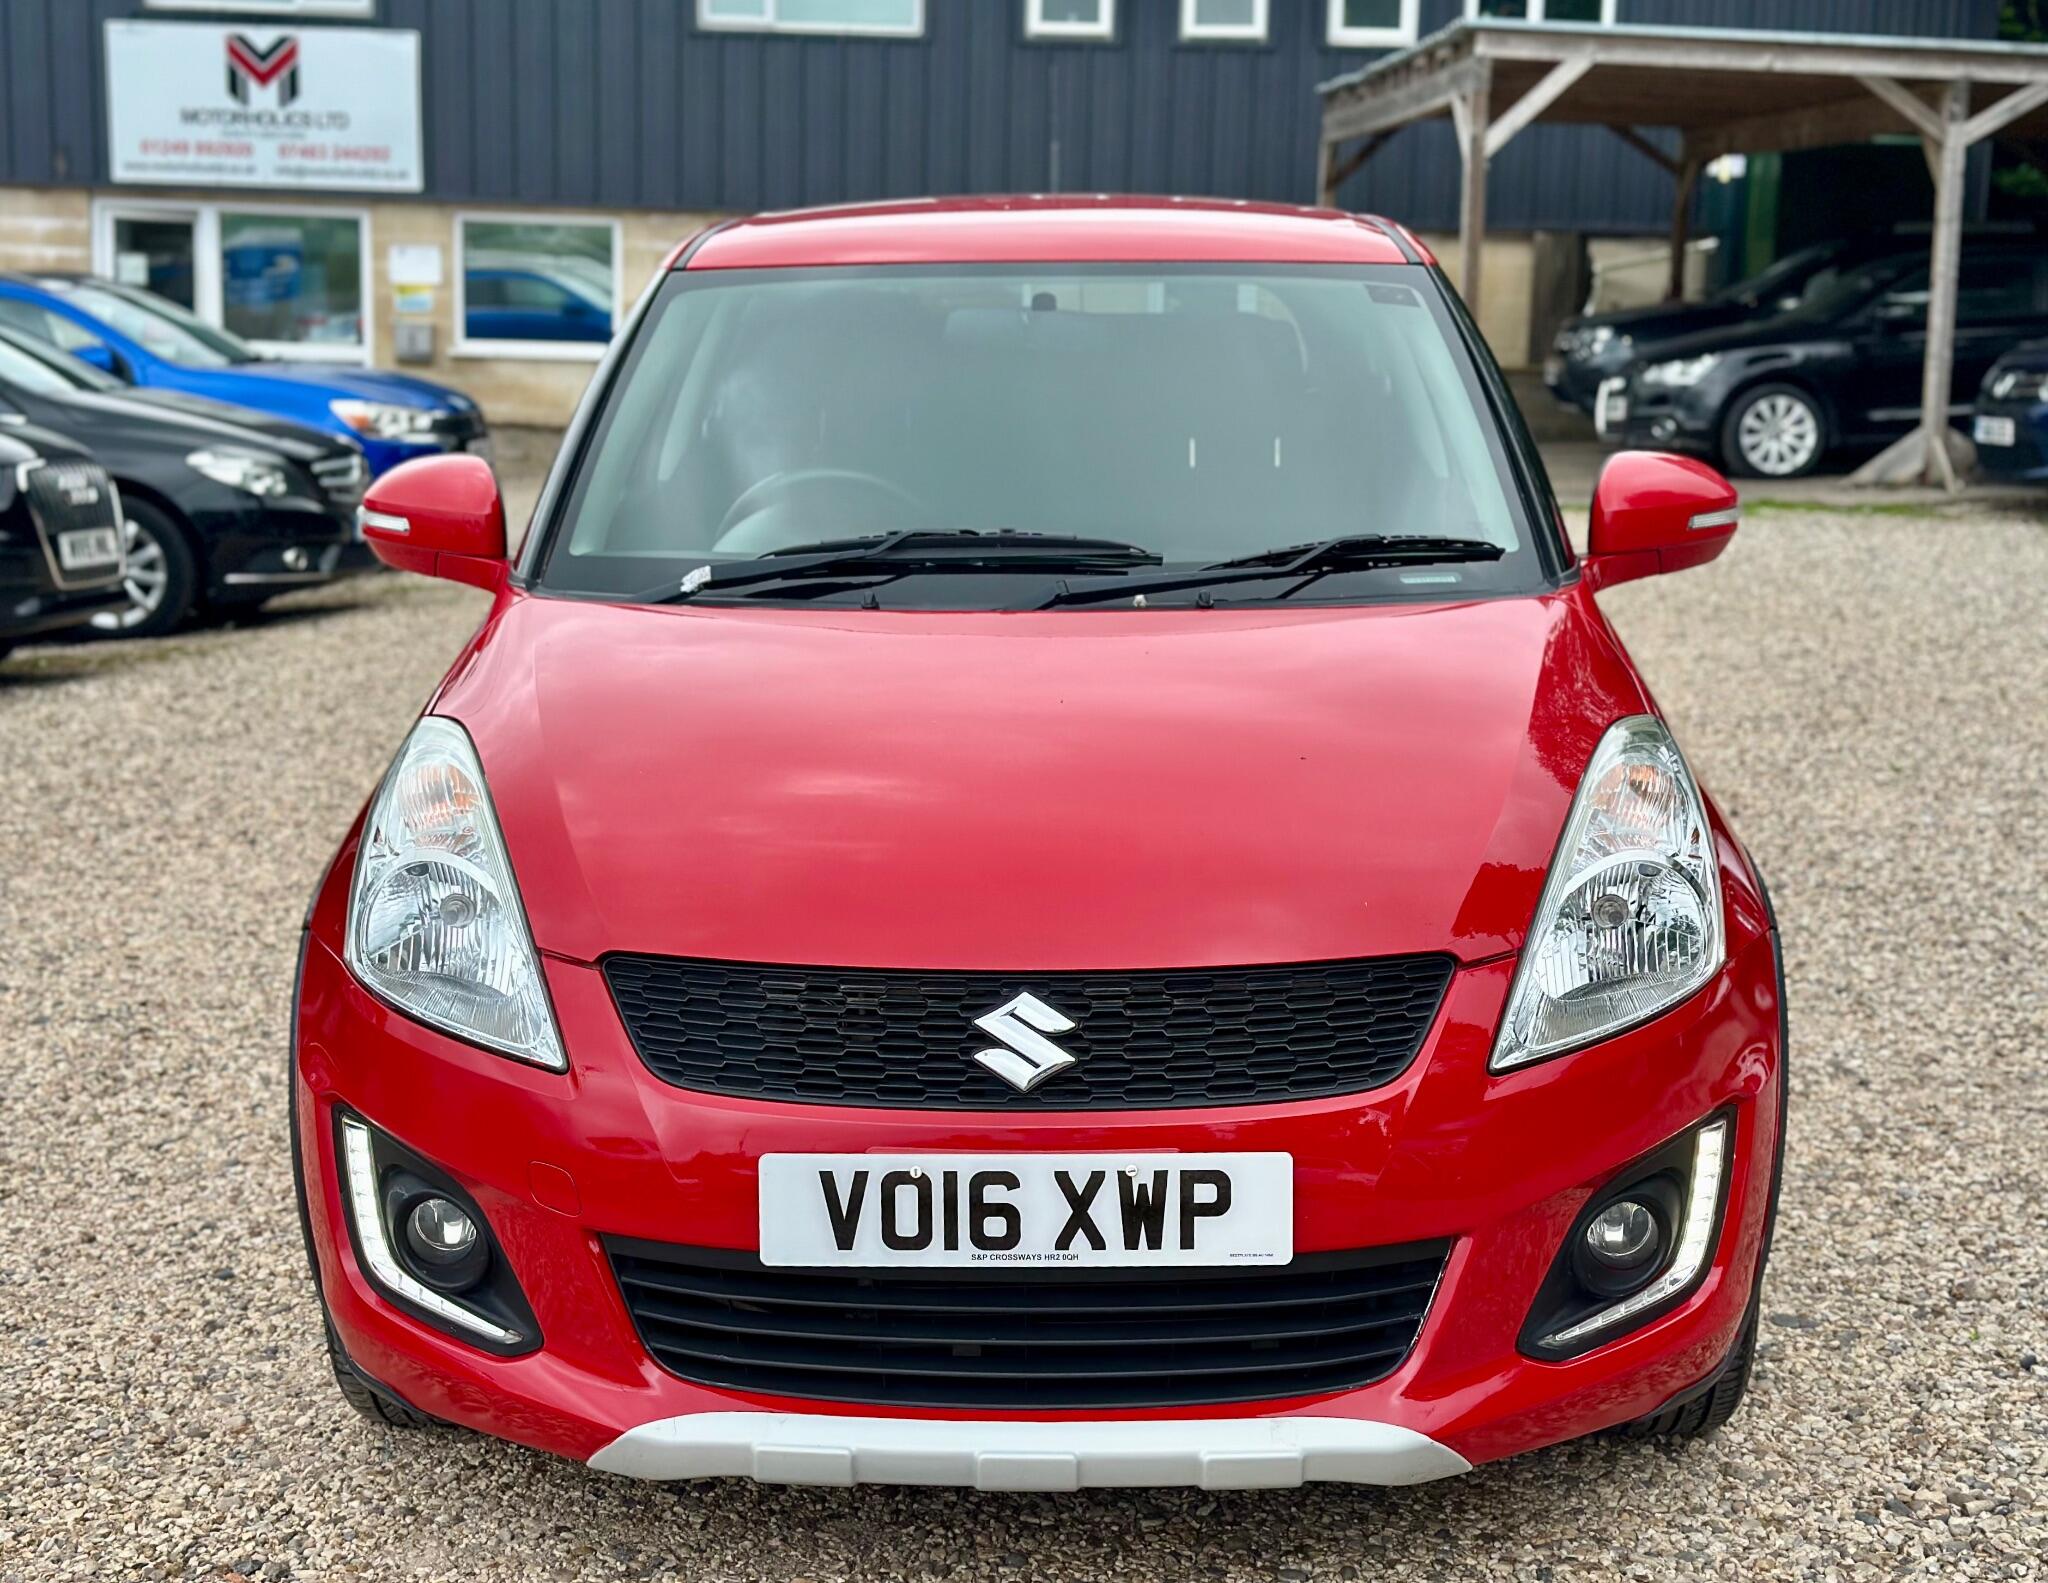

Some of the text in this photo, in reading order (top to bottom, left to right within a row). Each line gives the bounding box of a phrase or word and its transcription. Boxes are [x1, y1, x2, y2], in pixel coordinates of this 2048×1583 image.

[179, 108, 351, 131] MOTORHOLICS LTD
[819, 1170, 1231, 1251] VO16 XWP
[971, 1253, 988, 1261] S&P
[990, 1253, 1042, 1261] CROSSWAYS
[1044, 1253, 1061, 1261] HR2
